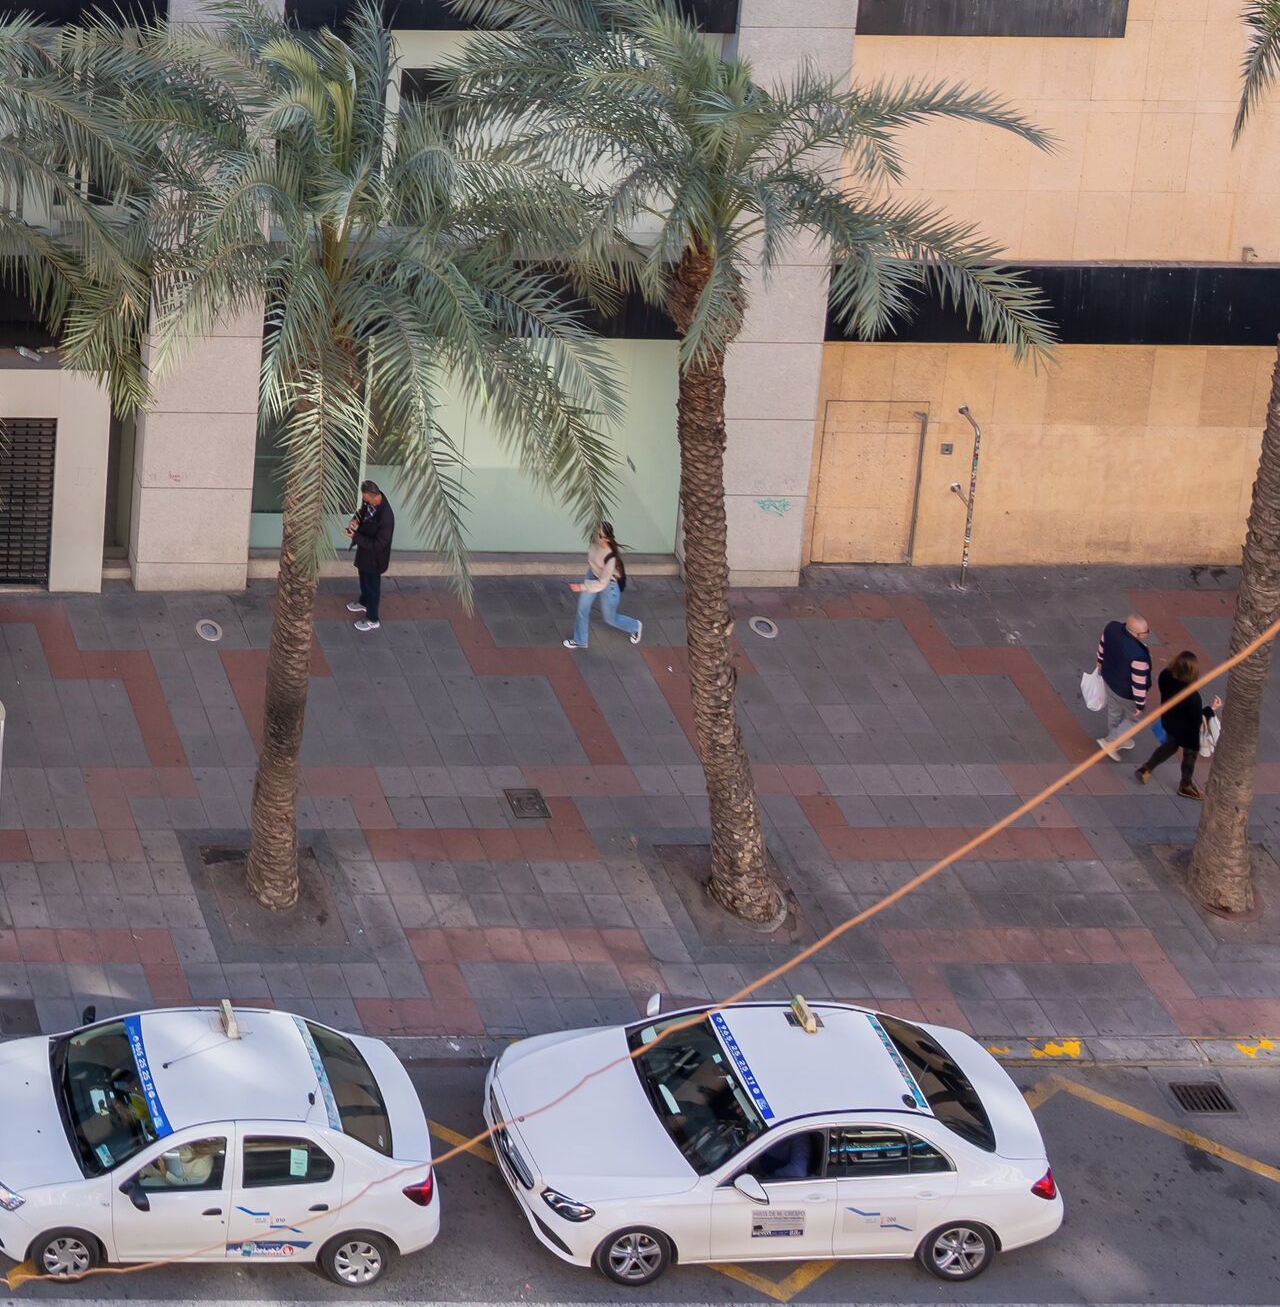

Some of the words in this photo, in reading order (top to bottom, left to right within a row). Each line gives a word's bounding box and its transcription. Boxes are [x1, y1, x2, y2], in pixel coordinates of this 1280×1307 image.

[135, 1042, 144, 1057] 965
[721, 1025, 733, 1042] 965
[731, 1045, 740, 1057] 25
[739, 1060, 748, 1072] 25
[139, 1058, 147, 1069] 25
[142, 1071, 150, 1081] 25
